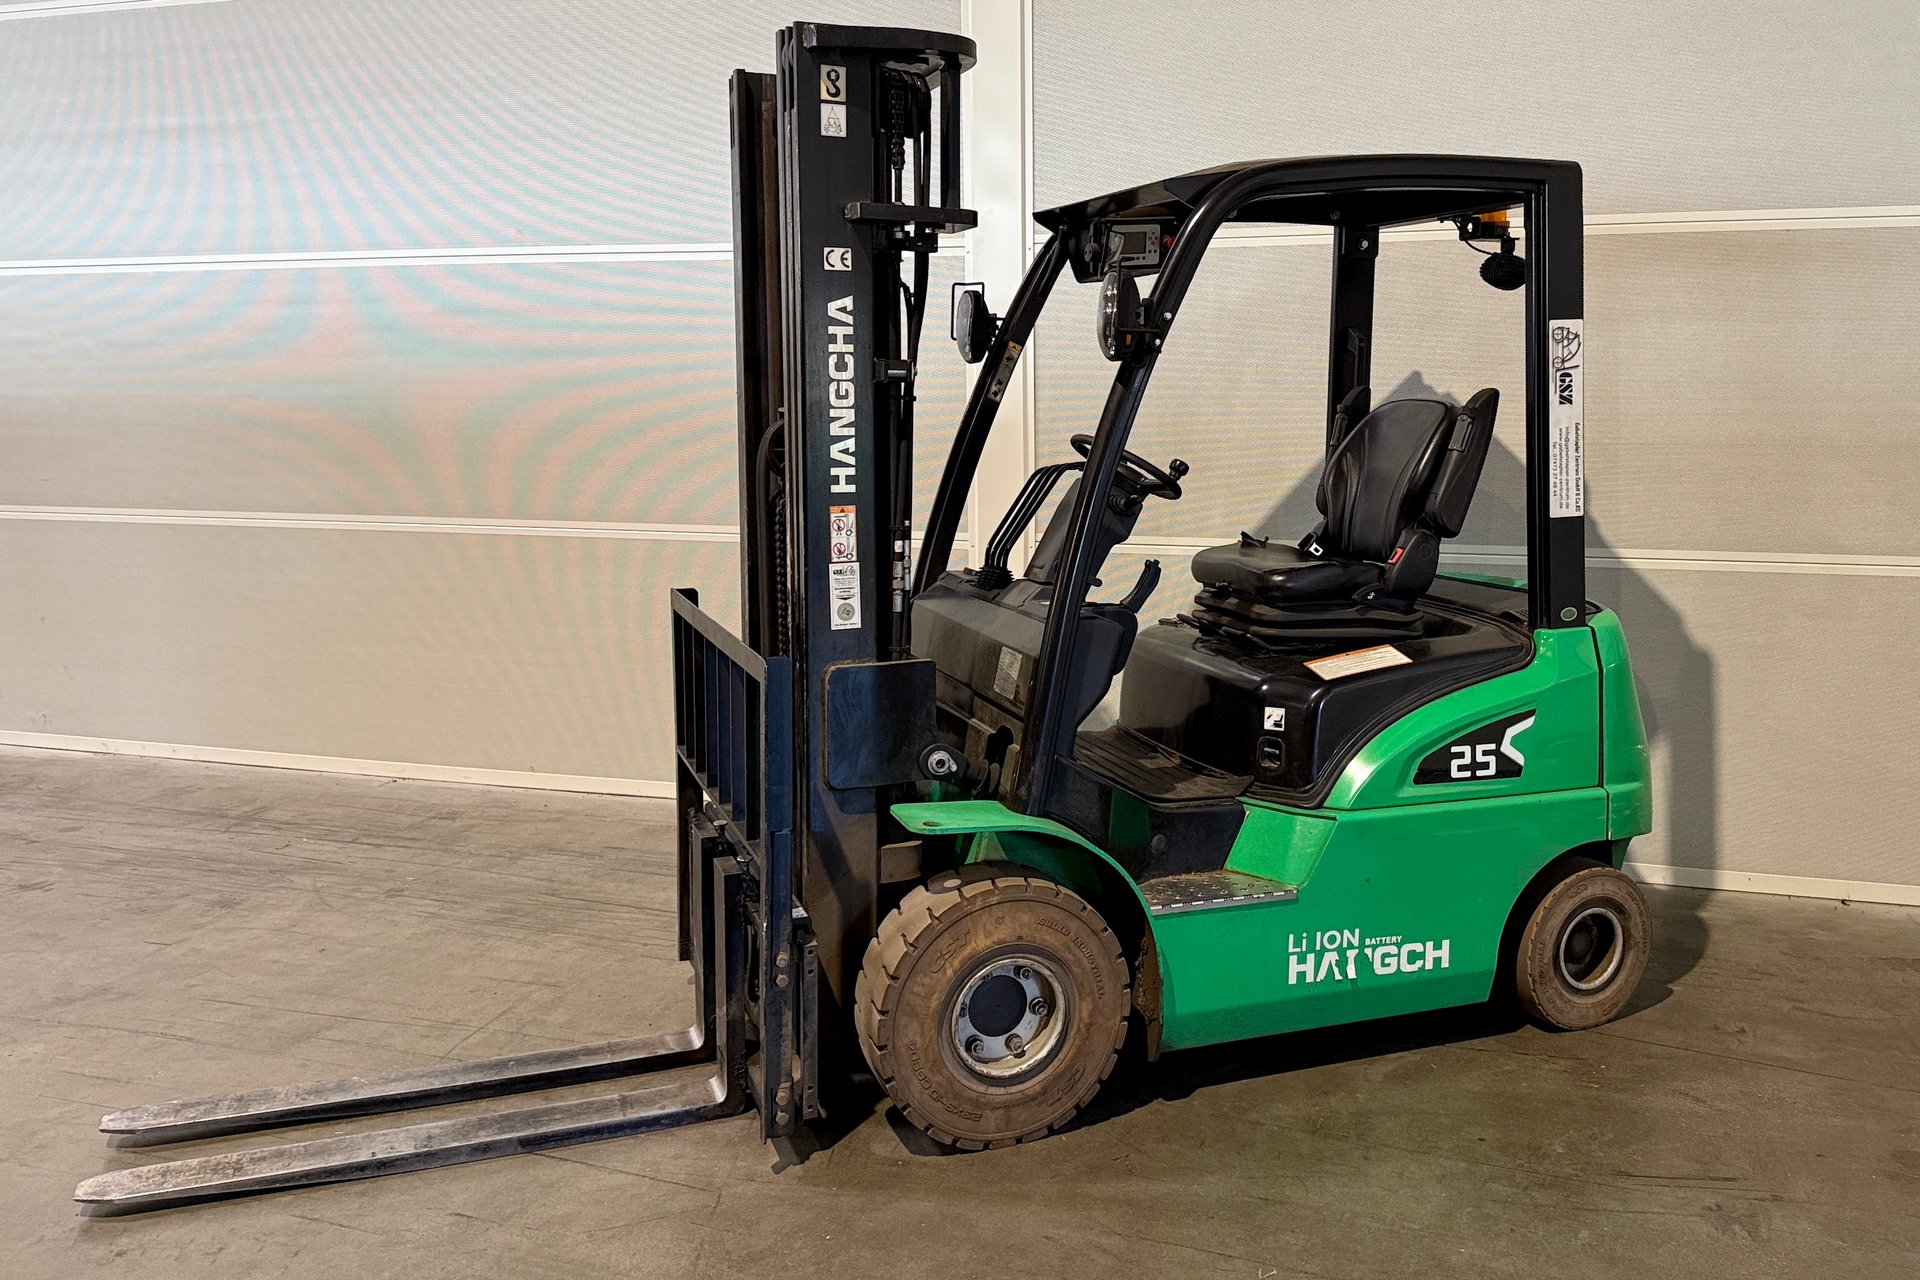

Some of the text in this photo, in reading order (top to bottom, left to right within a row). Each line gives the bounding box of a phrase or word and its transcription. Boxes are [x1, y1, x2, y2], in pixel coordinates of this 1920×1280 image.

[827, 295, 857, 493] HANGCHA
[1559, 372, 1573, 405] GSZ
[1451, 743, 1497, 778] 25
[1288, 928, 1403, 952] Li ION BATTERY
